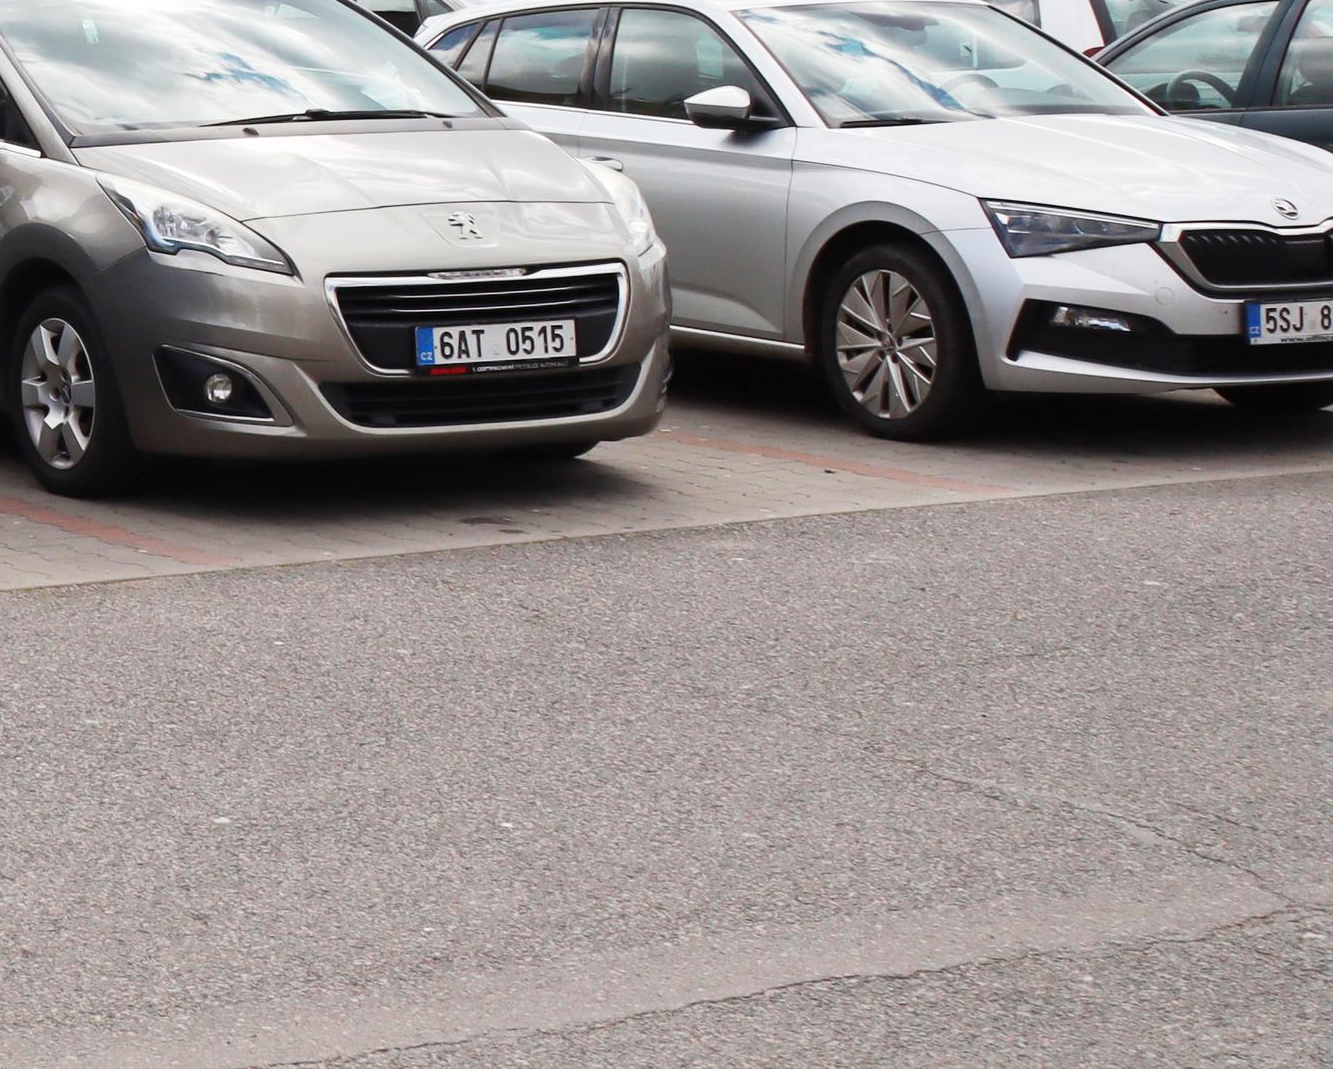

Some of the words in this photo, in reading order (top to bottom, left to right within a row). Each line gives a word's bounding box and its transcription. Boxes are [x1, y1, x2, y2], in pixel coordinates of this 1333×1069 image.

[1265, 305, 1304, 334] 5SJ
[420, 352, 433, 361] CZ
[439, 329, 485, 360] 6AT
[505, 324, 565, 356] 0515
